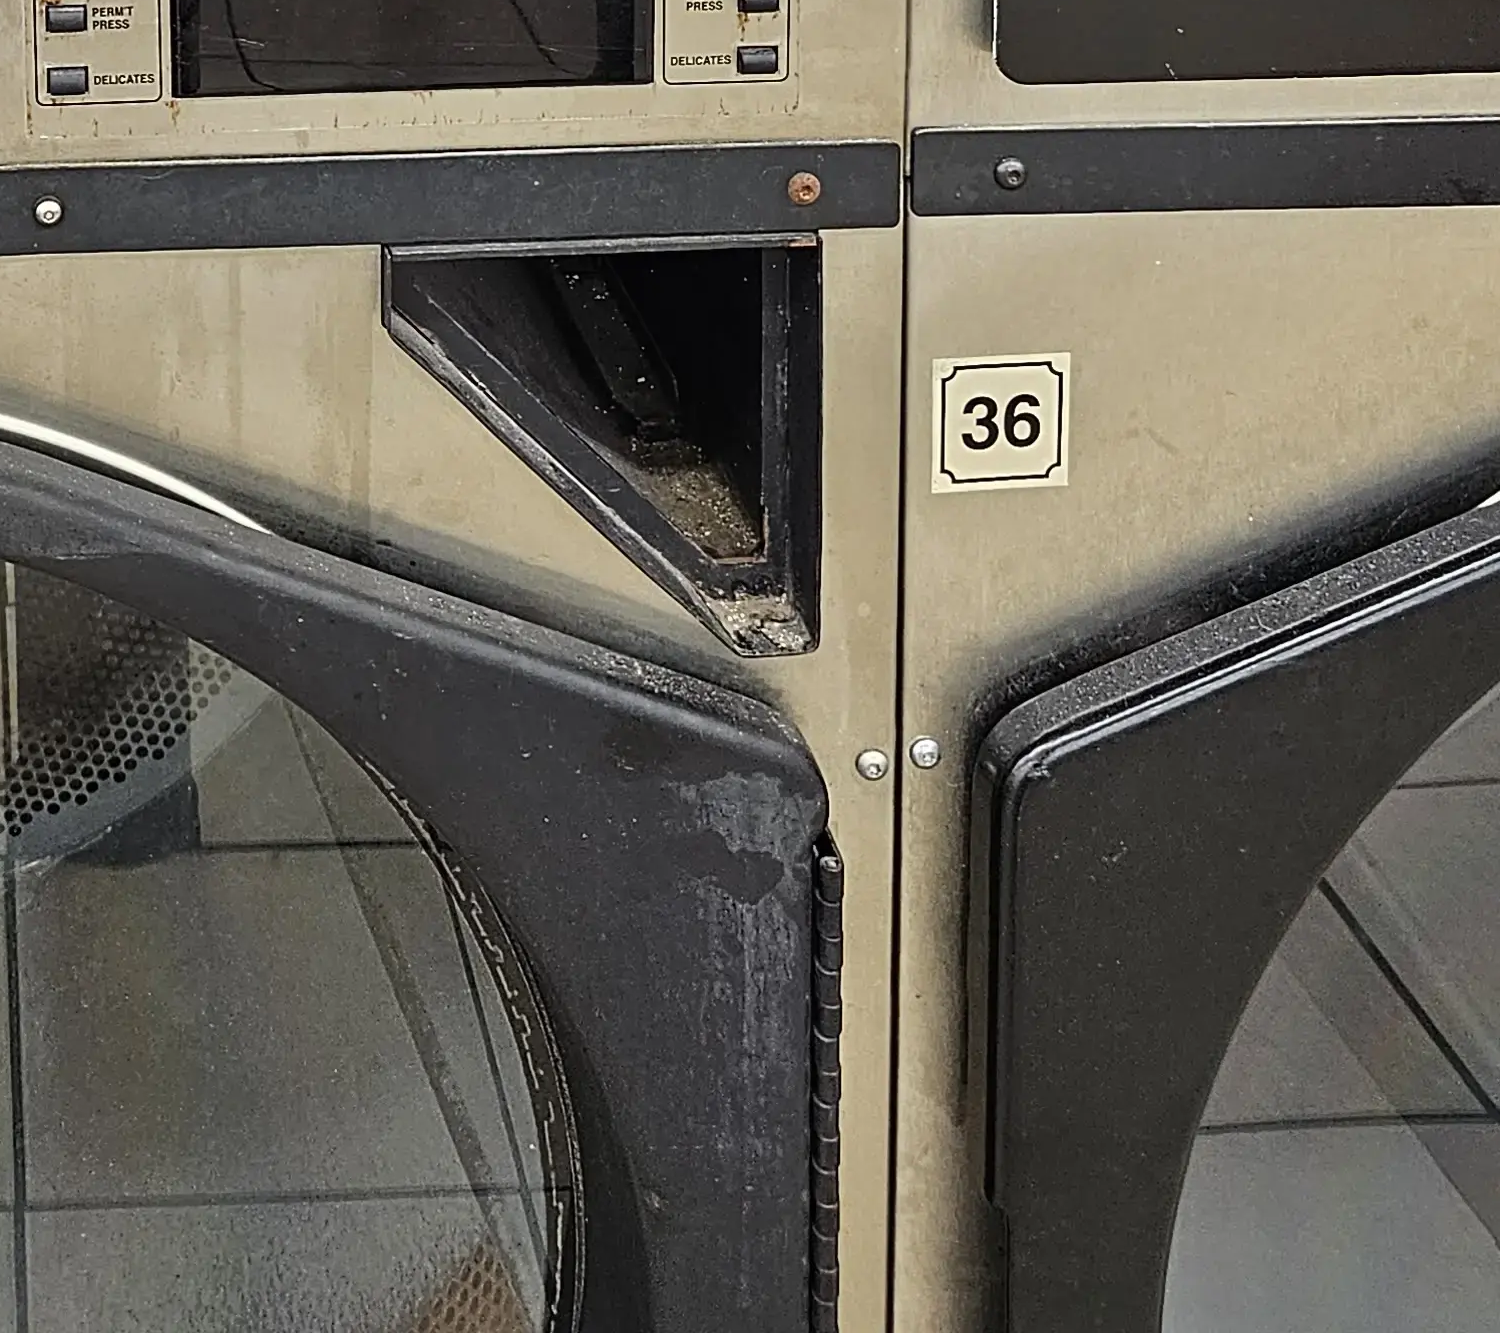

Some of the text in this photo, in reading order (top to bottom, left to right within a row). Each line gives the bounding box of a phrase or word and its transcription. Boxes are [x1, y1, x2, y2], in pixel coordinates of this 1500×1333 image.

[92, 6, 134, 17] PERM'T
[686, 1, 723, 11] PRESS
[92, 19, 130, 30] PRESS
[670, 55, 732, 66] DELICATES
[93, 74, 155, 85] DELICATES
[961, 394, 1041, 450] 36
